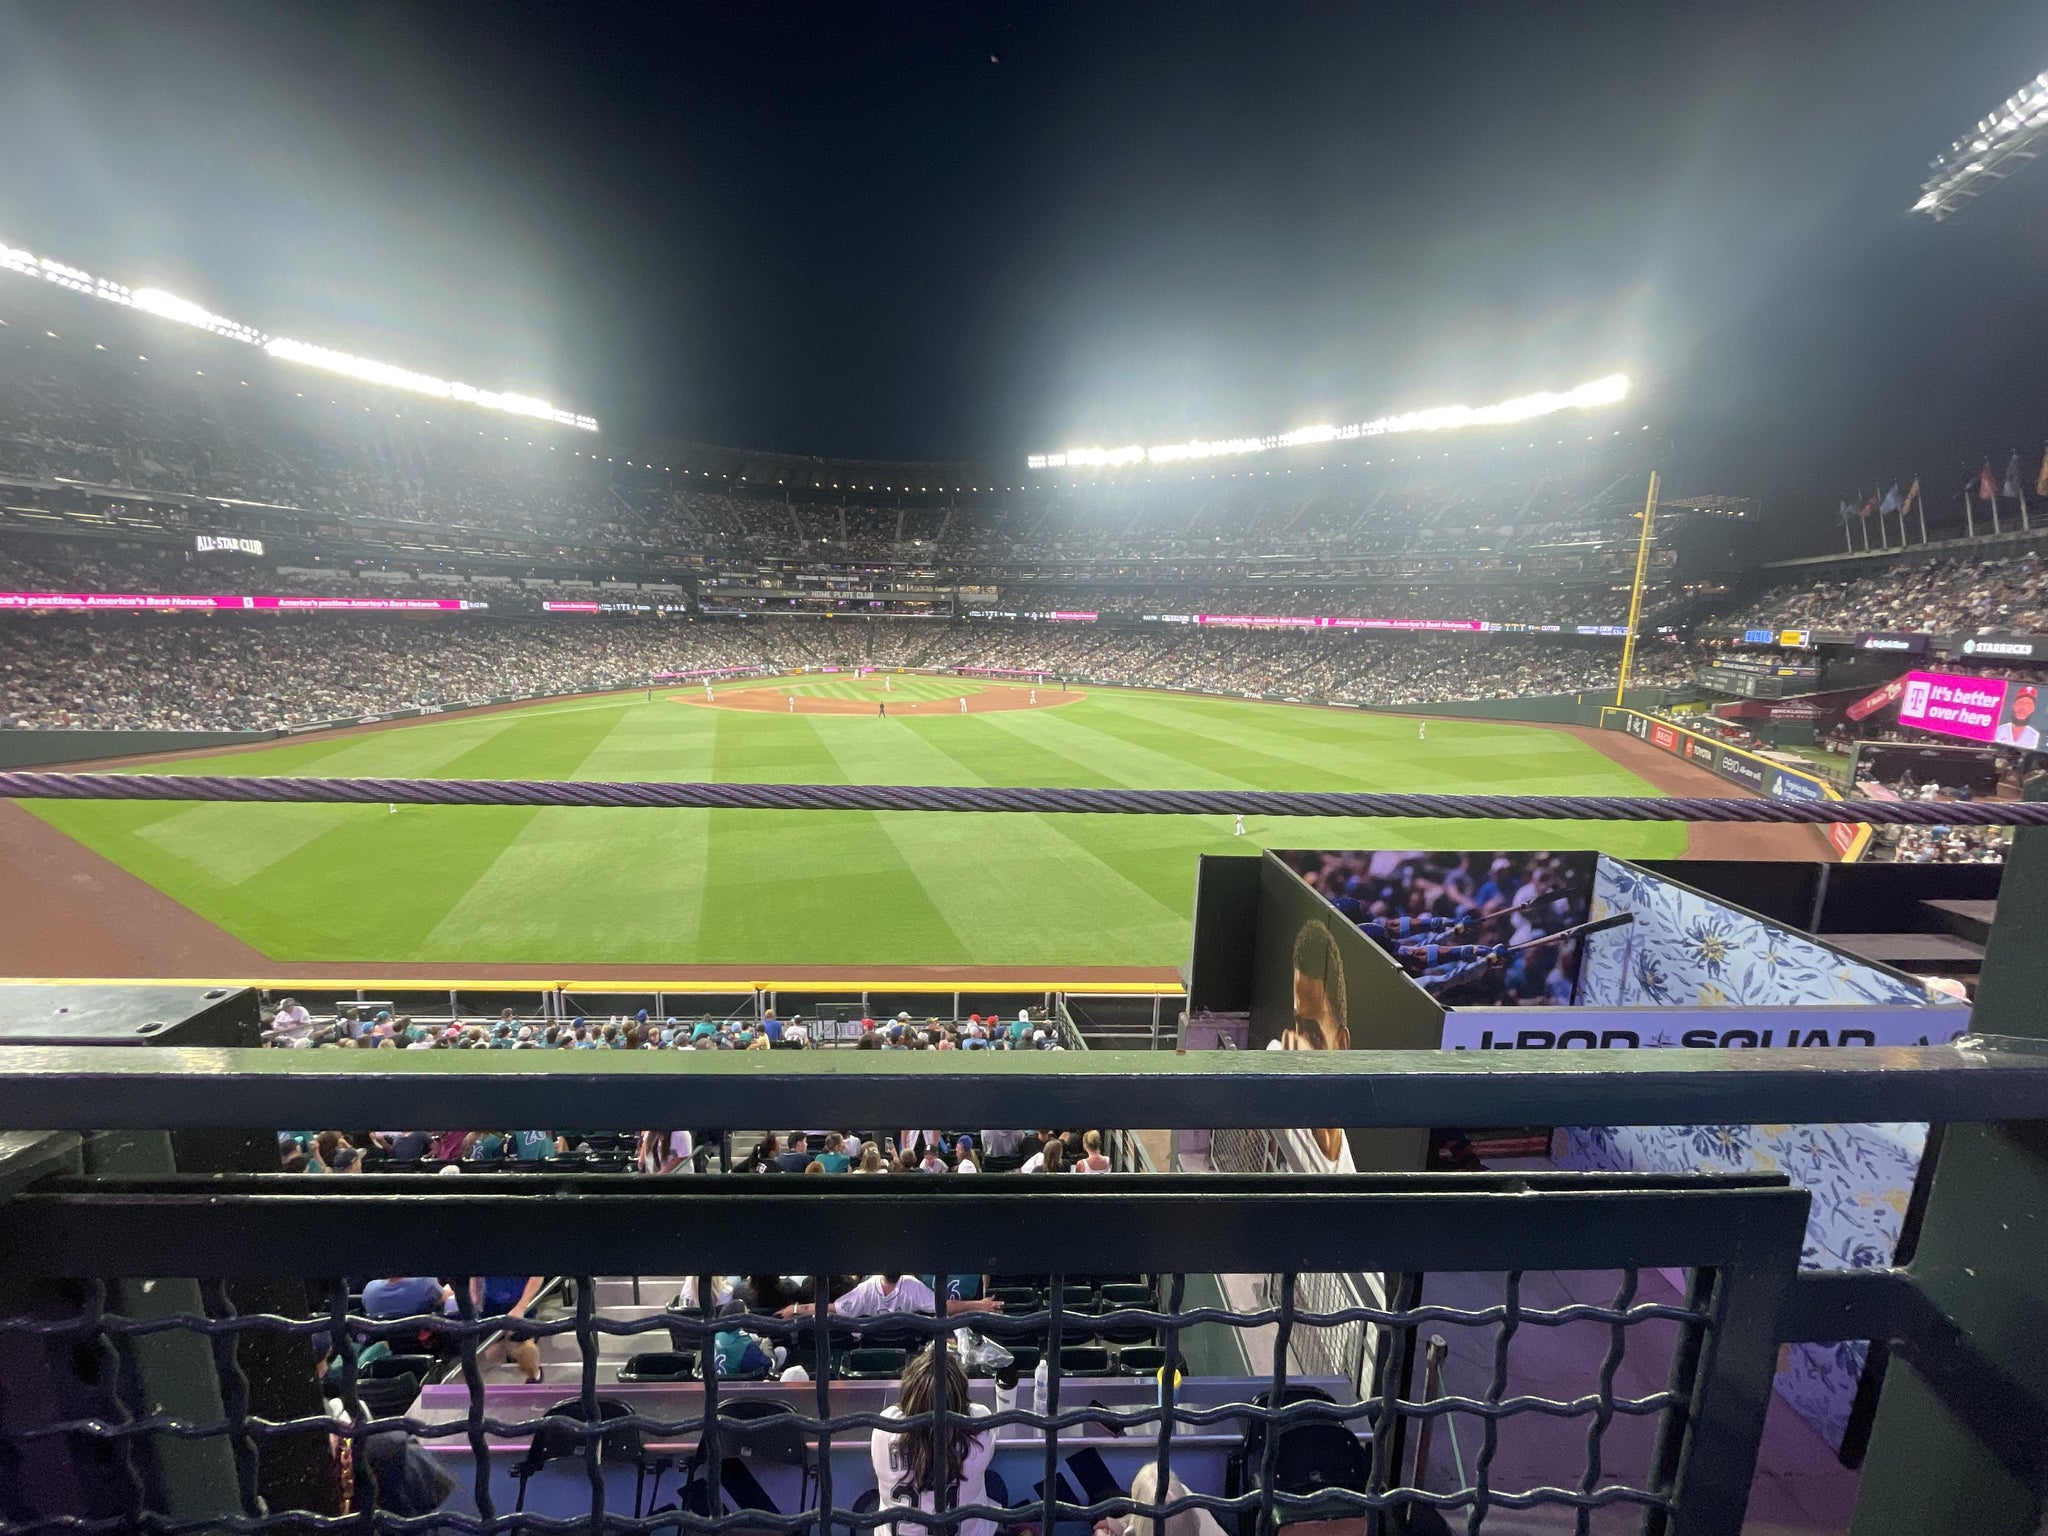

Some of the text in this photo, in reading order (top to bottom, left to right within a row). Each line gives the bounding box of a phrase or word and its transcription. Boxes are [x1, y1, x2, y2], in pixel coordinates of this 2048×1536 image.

[197, 535, 263, 555] ALL-STAR CLUB
[811, 590, 831, 598] HOME
[833, 591, 854, 599] PLATE
[1976, 643, 2032, 655] STARBUCKS
[1931, 686, 2000, 708] It's better
[1929, 706, 1992, 727] over here
[1694, 745, 1711, 760] TOYOTA
[1722, 756, 1739, 773] eero
[1681, 1029, 1875, 1049] SQUAD
